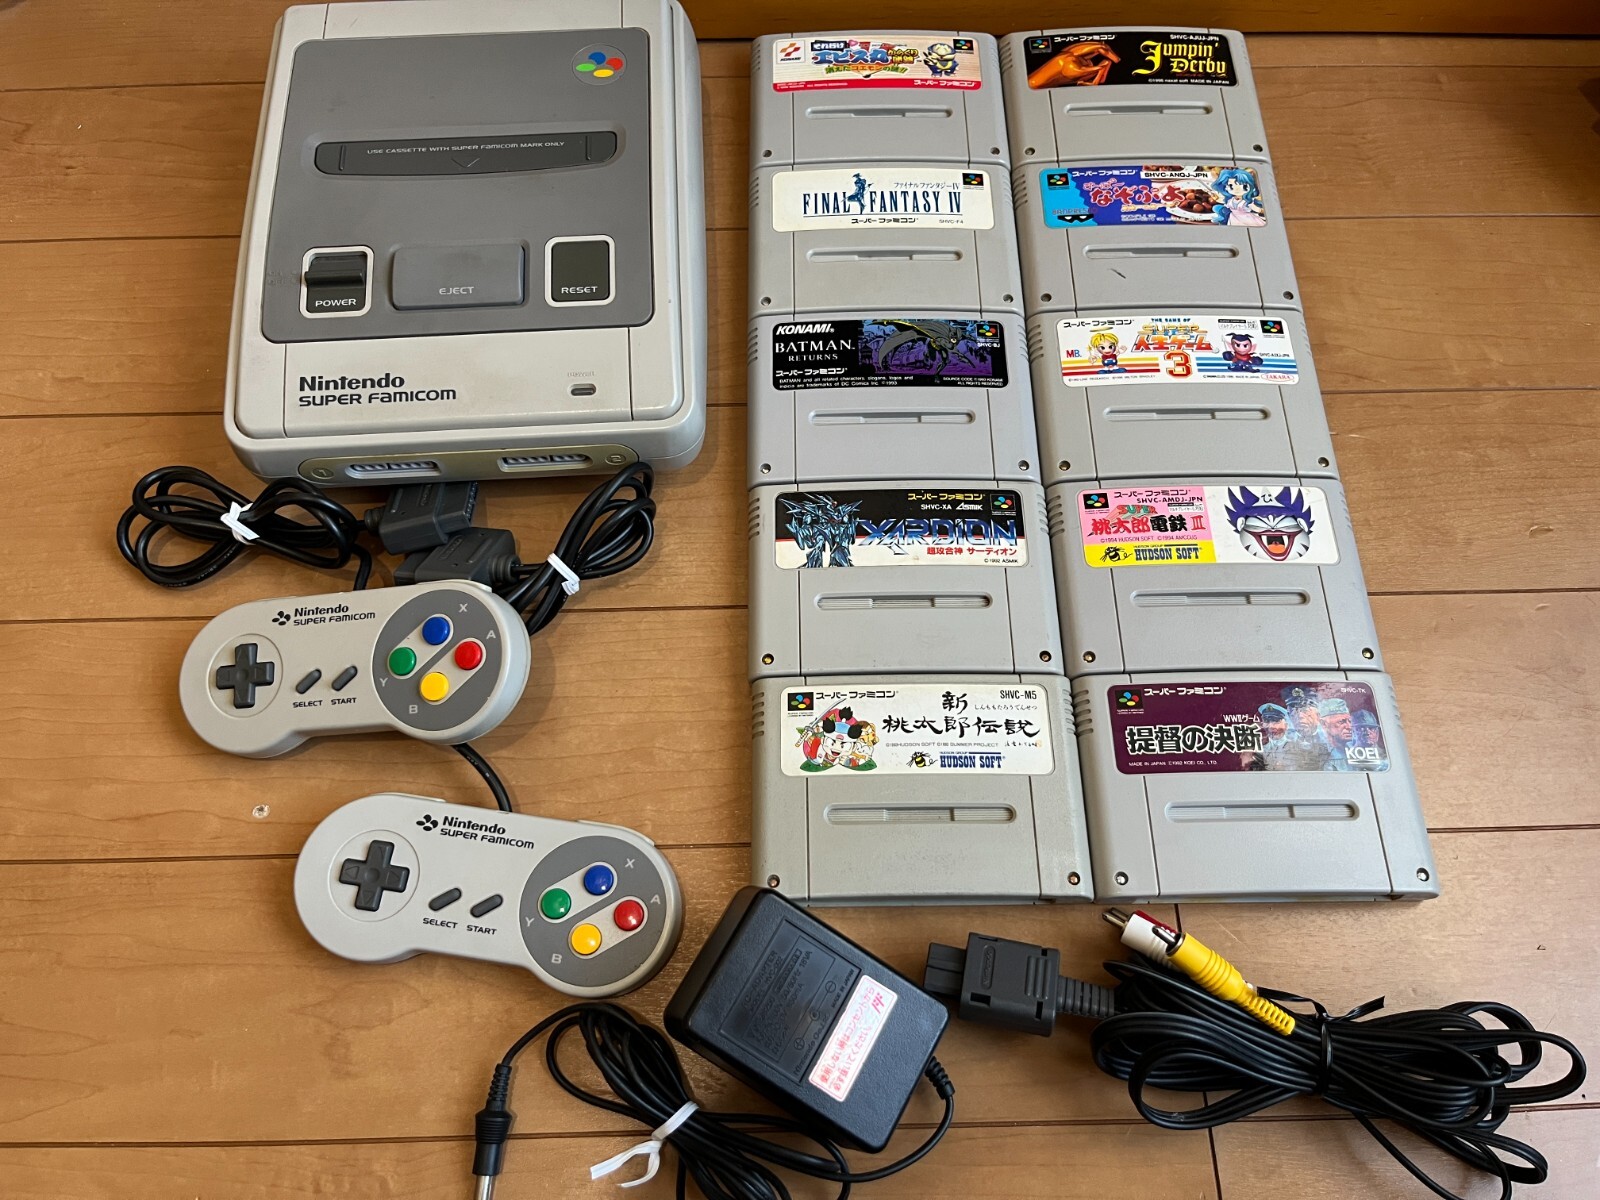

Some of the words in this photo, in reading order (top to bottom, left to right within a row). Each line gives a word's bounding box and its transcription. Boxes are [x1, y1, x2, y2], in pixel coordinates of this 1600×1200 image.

[1053, 34, 1115, 42] スーパーファミコン
[1132, 40, 1219, 75] Jumpin'
[1170, 58, 1227, 78] Derby
[1089, 184, 1186, 207] なぞぷよ
[803, 191, 850, 214] FINAL
[869, 191, 940, 214] FANTASY
[948, 191, 961, 213] IV
[438, 286, 474, 295] EJECT
[561, 286, 598, 294] RESET
[315, 298, 357, 307] POWER
[776, 323, 830, 335] KONAMI
[1063, 319, 1133, 328] スーパーファミコン
[775, 339, 851, 353] BATMAN
[1131, 334, 1213, 352] 人生ゲーム
[788, 353, 838, 362] RETURNS
[1164, 350, 1193, 378] 3
[775, 368, 844, 377] スーパーファミコン
[299, 372, 405, 392] Nintendo
[299, 393, 362, 407] SUPER
[368, 389, 456, 404] Famicom
[1114, 490, 1188, 498] スーパーファミコン
[1136, 496, 1203, 504] SHVC-AMDJ-JPN
[1116, 505, 1159, 515] SUPER
[1090, 514, 1188, 536] 桃太郎電鉄
[857, 518, 1018, 555] XARDION
[967, 547, 1017, 556] サーティオン
[1134, 548, 1173, 561] HUDSON
[1176, 547, 1199, 559] SOFT
[294, 604, 349, 617] Nintendo
[458, 603, 468, 613] X
[293, 616, 326, 626] SUPER
[329, 612, 376, 623] Famicom
[486, 630, 497, 640] A
[379, 677, 388, 687] Y
[815, 691, 896, 700] スーパーファミコン
[1000, 690, 1037, 700] SHVC-M5
[1144, 687, 1224, 696] スーパーファミコン
[293, 700, 323, 709] SELECT
[331, 697, 357, 706] START
[942, 691, 968, 715] 新
[409, 705, 418, 714] B
[882, 715, 1040, 738] 桃太郎伝説
[1125, 724, 1263, 755] 提督の決断
[1344, 747, 1379, 759] KOEI
[940, 756, 976, 768] HUDSON
[980, 756, 1002, 768] SOFT
[442, 815, 506, 835] Nintendo
[440, 827, 478, 841] SUPER
[480, 834, 534, 850] Famicom
[624, 858, 636, 869] X
[650, 894, 661, 905] A
[422, 917, 458, 929] SELECT
[524, 916, 535, 927] Y
[466, 924, 497, 935] START
[551, 953, 562, 964] B
